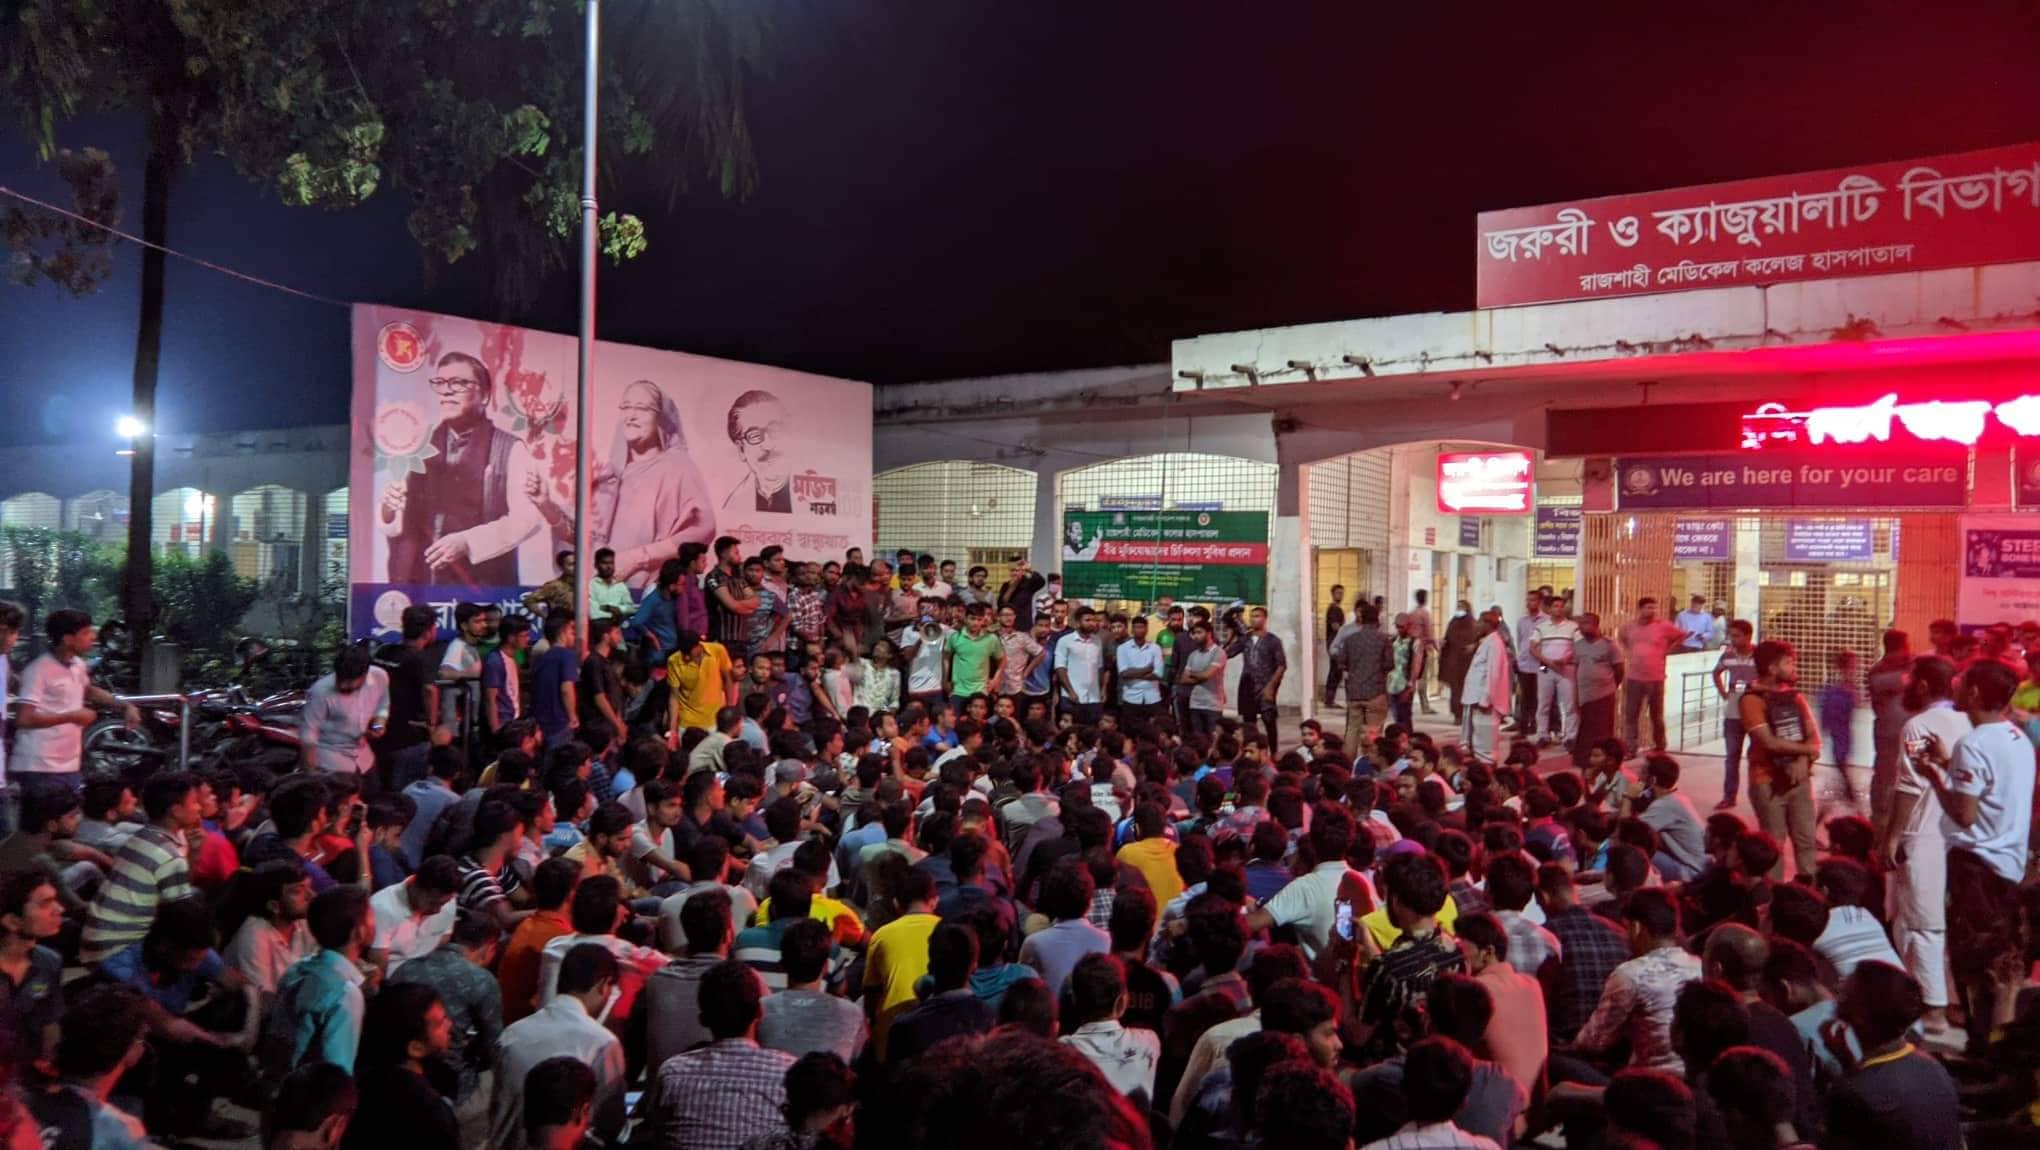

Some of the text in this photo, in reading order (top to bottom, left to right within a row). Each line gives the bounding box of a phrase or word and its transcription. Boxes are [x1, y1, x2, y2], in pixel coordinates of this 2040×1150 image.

[1485, 162, 2040, 262] জরুরী ও ক্যাজুয়ালটি বিভাগ
[1579, 243, 1915, 291] রাজশাহী মেডিকেল কলেজ হাসপাতাল
[793, 469, 837, 502] মুজিব
[1661, 465, 1958, 488] We are here for your care
